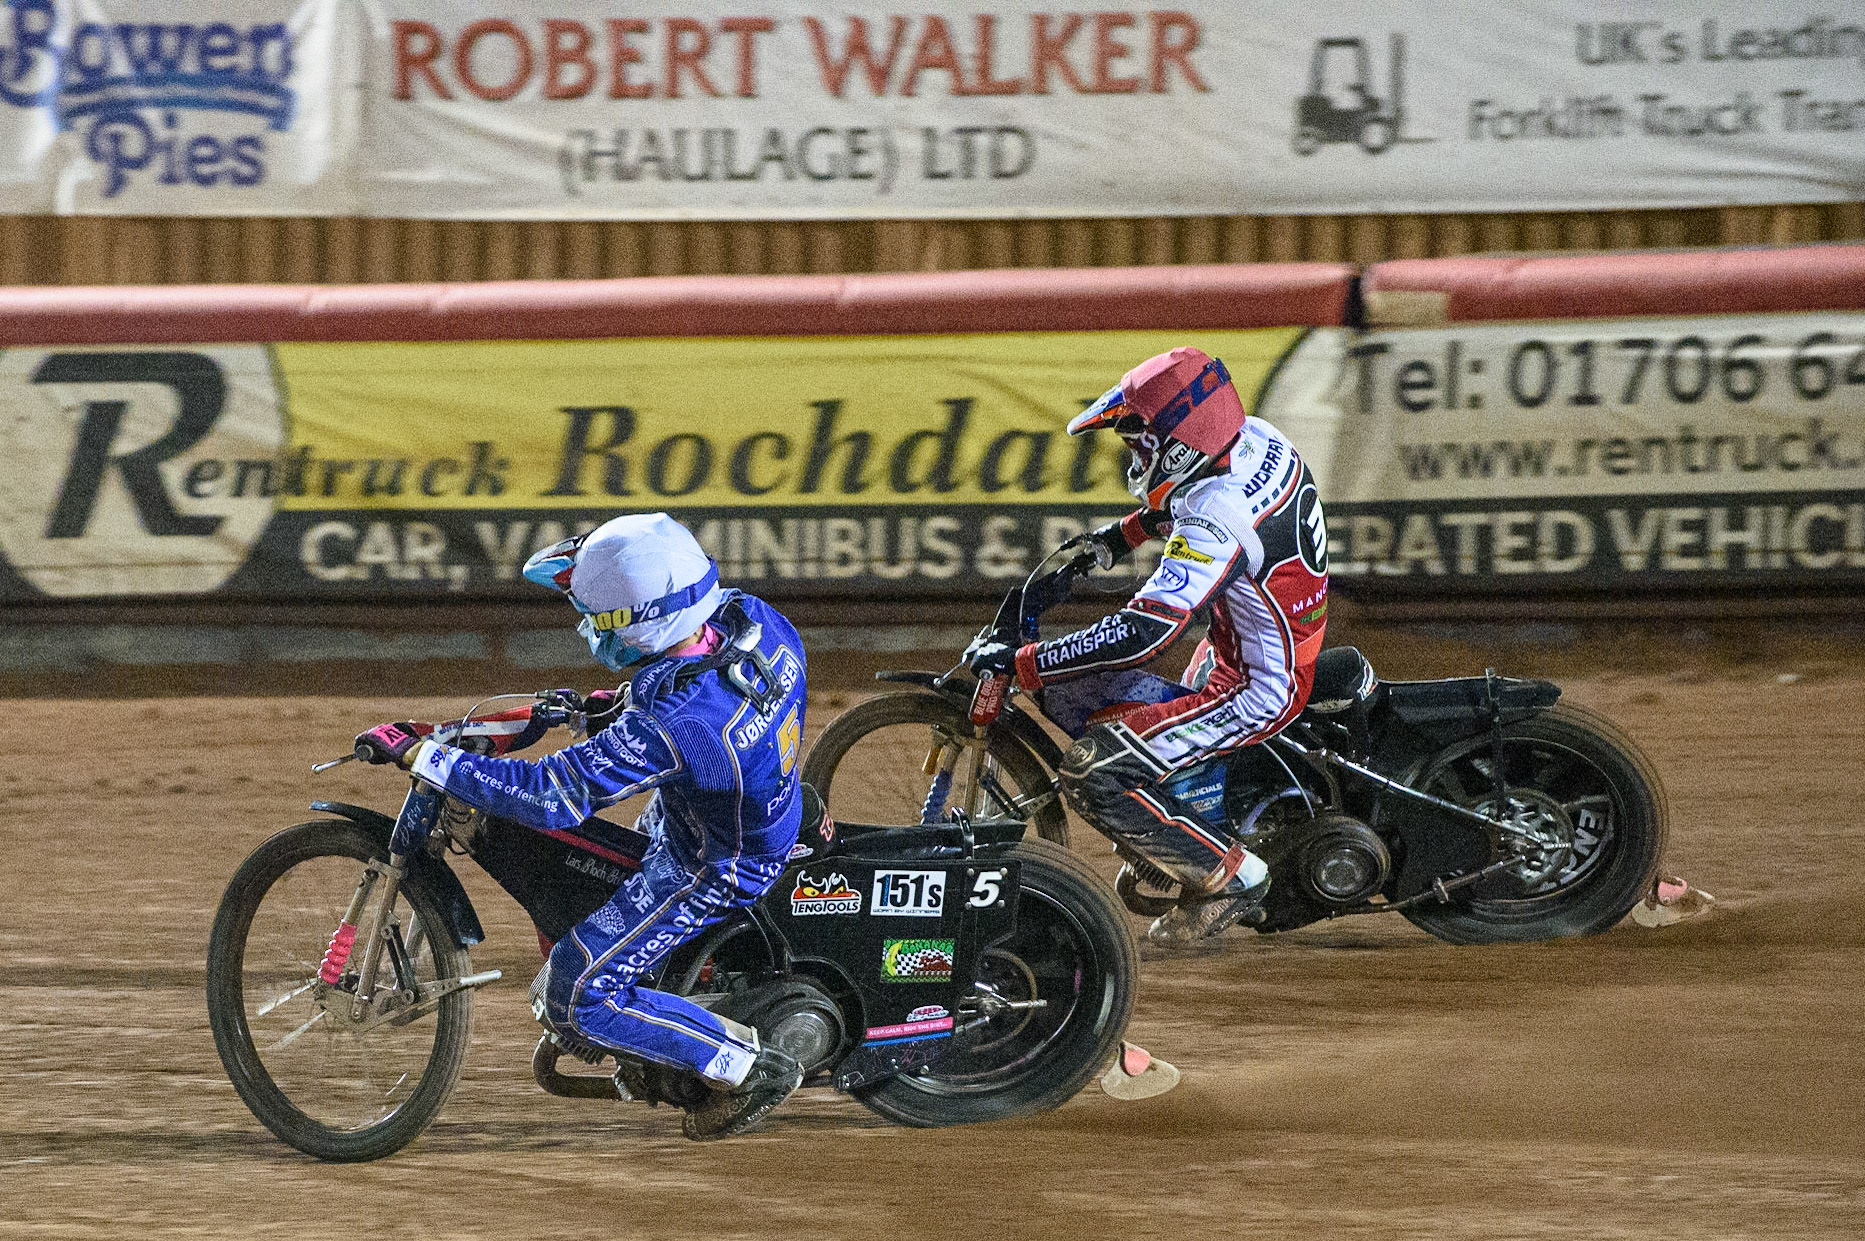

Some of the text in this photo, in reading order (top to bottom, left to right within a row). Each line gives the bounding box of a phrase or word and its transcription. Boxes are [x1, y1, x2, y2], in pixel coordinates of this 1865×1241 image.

[391, 9, 1211, 101] ROBERT WALKER
[1701, 14, 1865, 70] Leadin
[86, 110, 267, 198] Pies
[562, 124, 1038, 196] (HAULAGE) LTD
[1349, 337, 1485, 415] Tel:
[1508, 333, 1765, 408] 01706
[538, 396, 1132, 498] Rochdal
[302, 521, 466, 592] CAR,
[776, 703, 800, 777] 5
[473, 769, 558, 813] acres of fencing
[969, 871, 1003, 908] 5
[616, 929, 674, 977] acres
